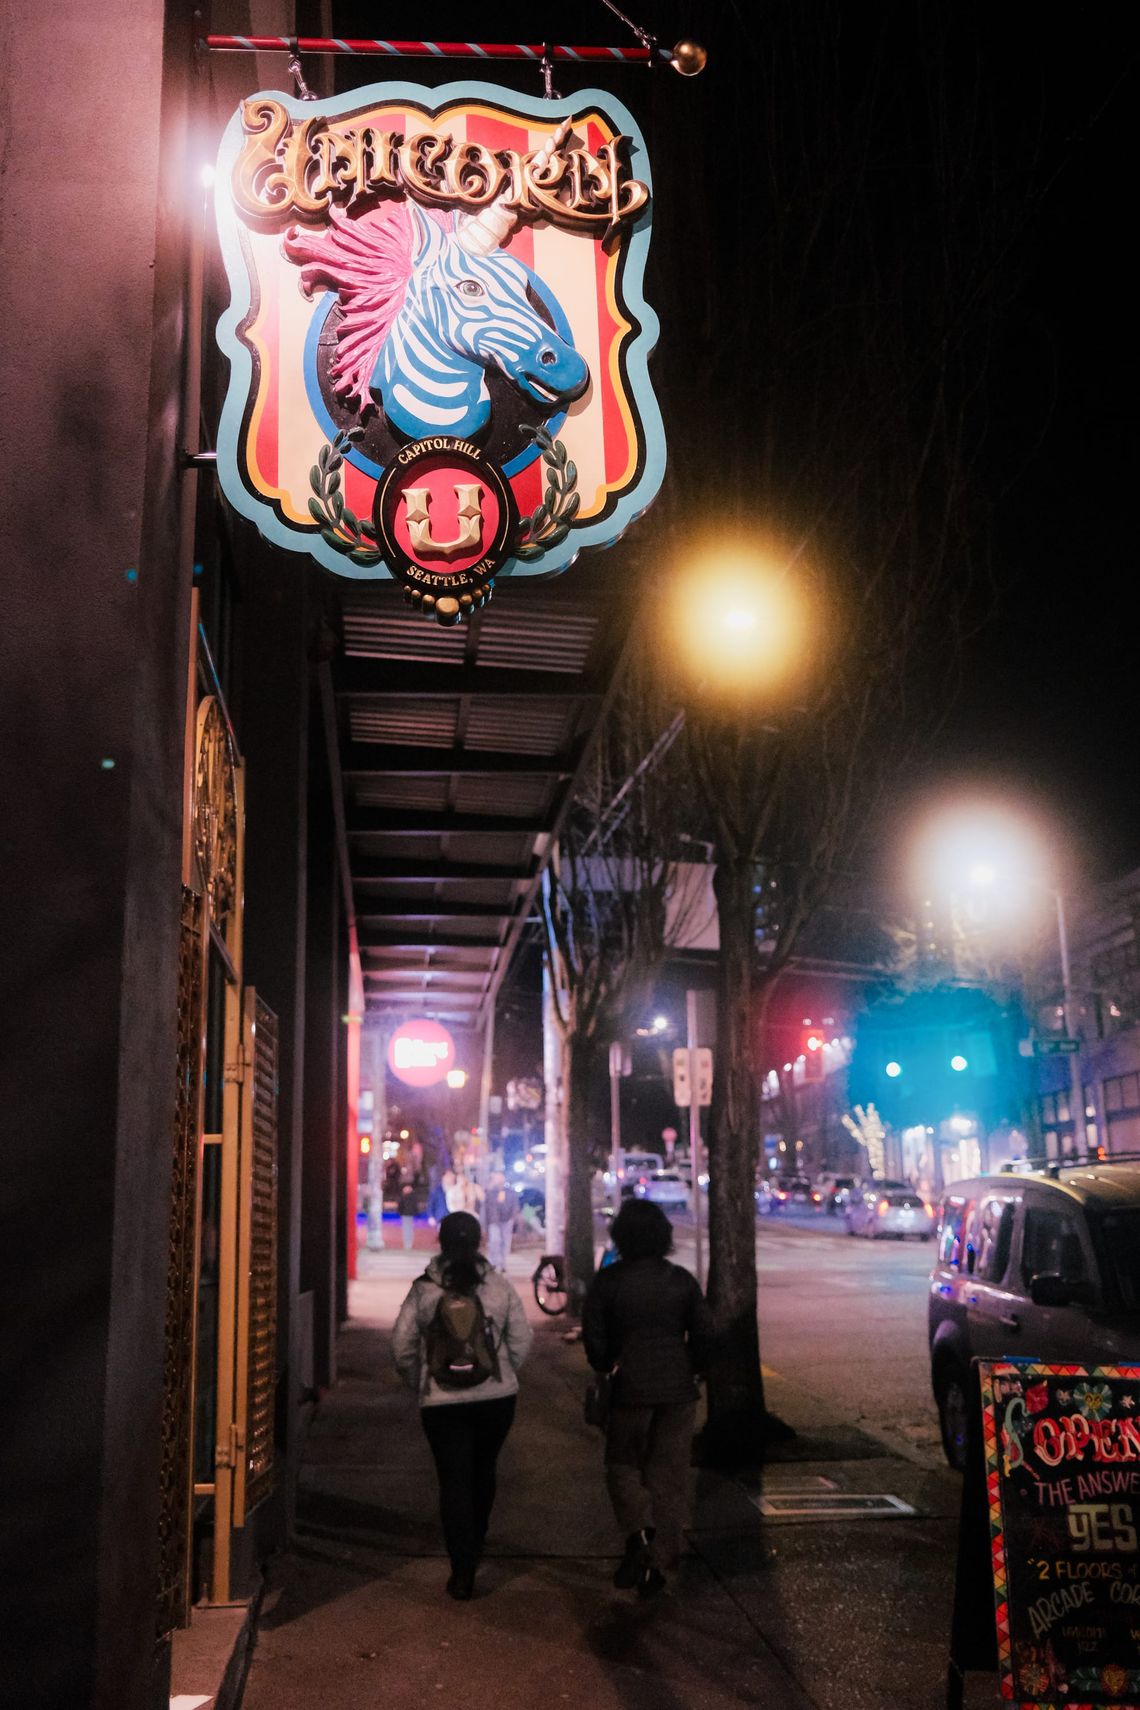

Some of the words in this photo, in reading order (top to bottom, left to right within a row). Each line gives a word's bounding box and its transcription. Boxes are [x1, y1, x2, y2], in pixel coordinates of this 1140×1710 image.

[398, 438, 450, 464] CAPITOL
[453, 439, 481, 460] HILL
[401, 484, 482, 555] U
[406, 565, 473, 587] SEATTLE,
[474, 558, 496, 576] WA
[1033, 1413, 1140, 1467] OPEN
[1034, 1478, 1076, 1506] THE
[1055, 1562, 1123, 1581] FLOORS
[1027, 1582, 1096, 1639] ARCADE
